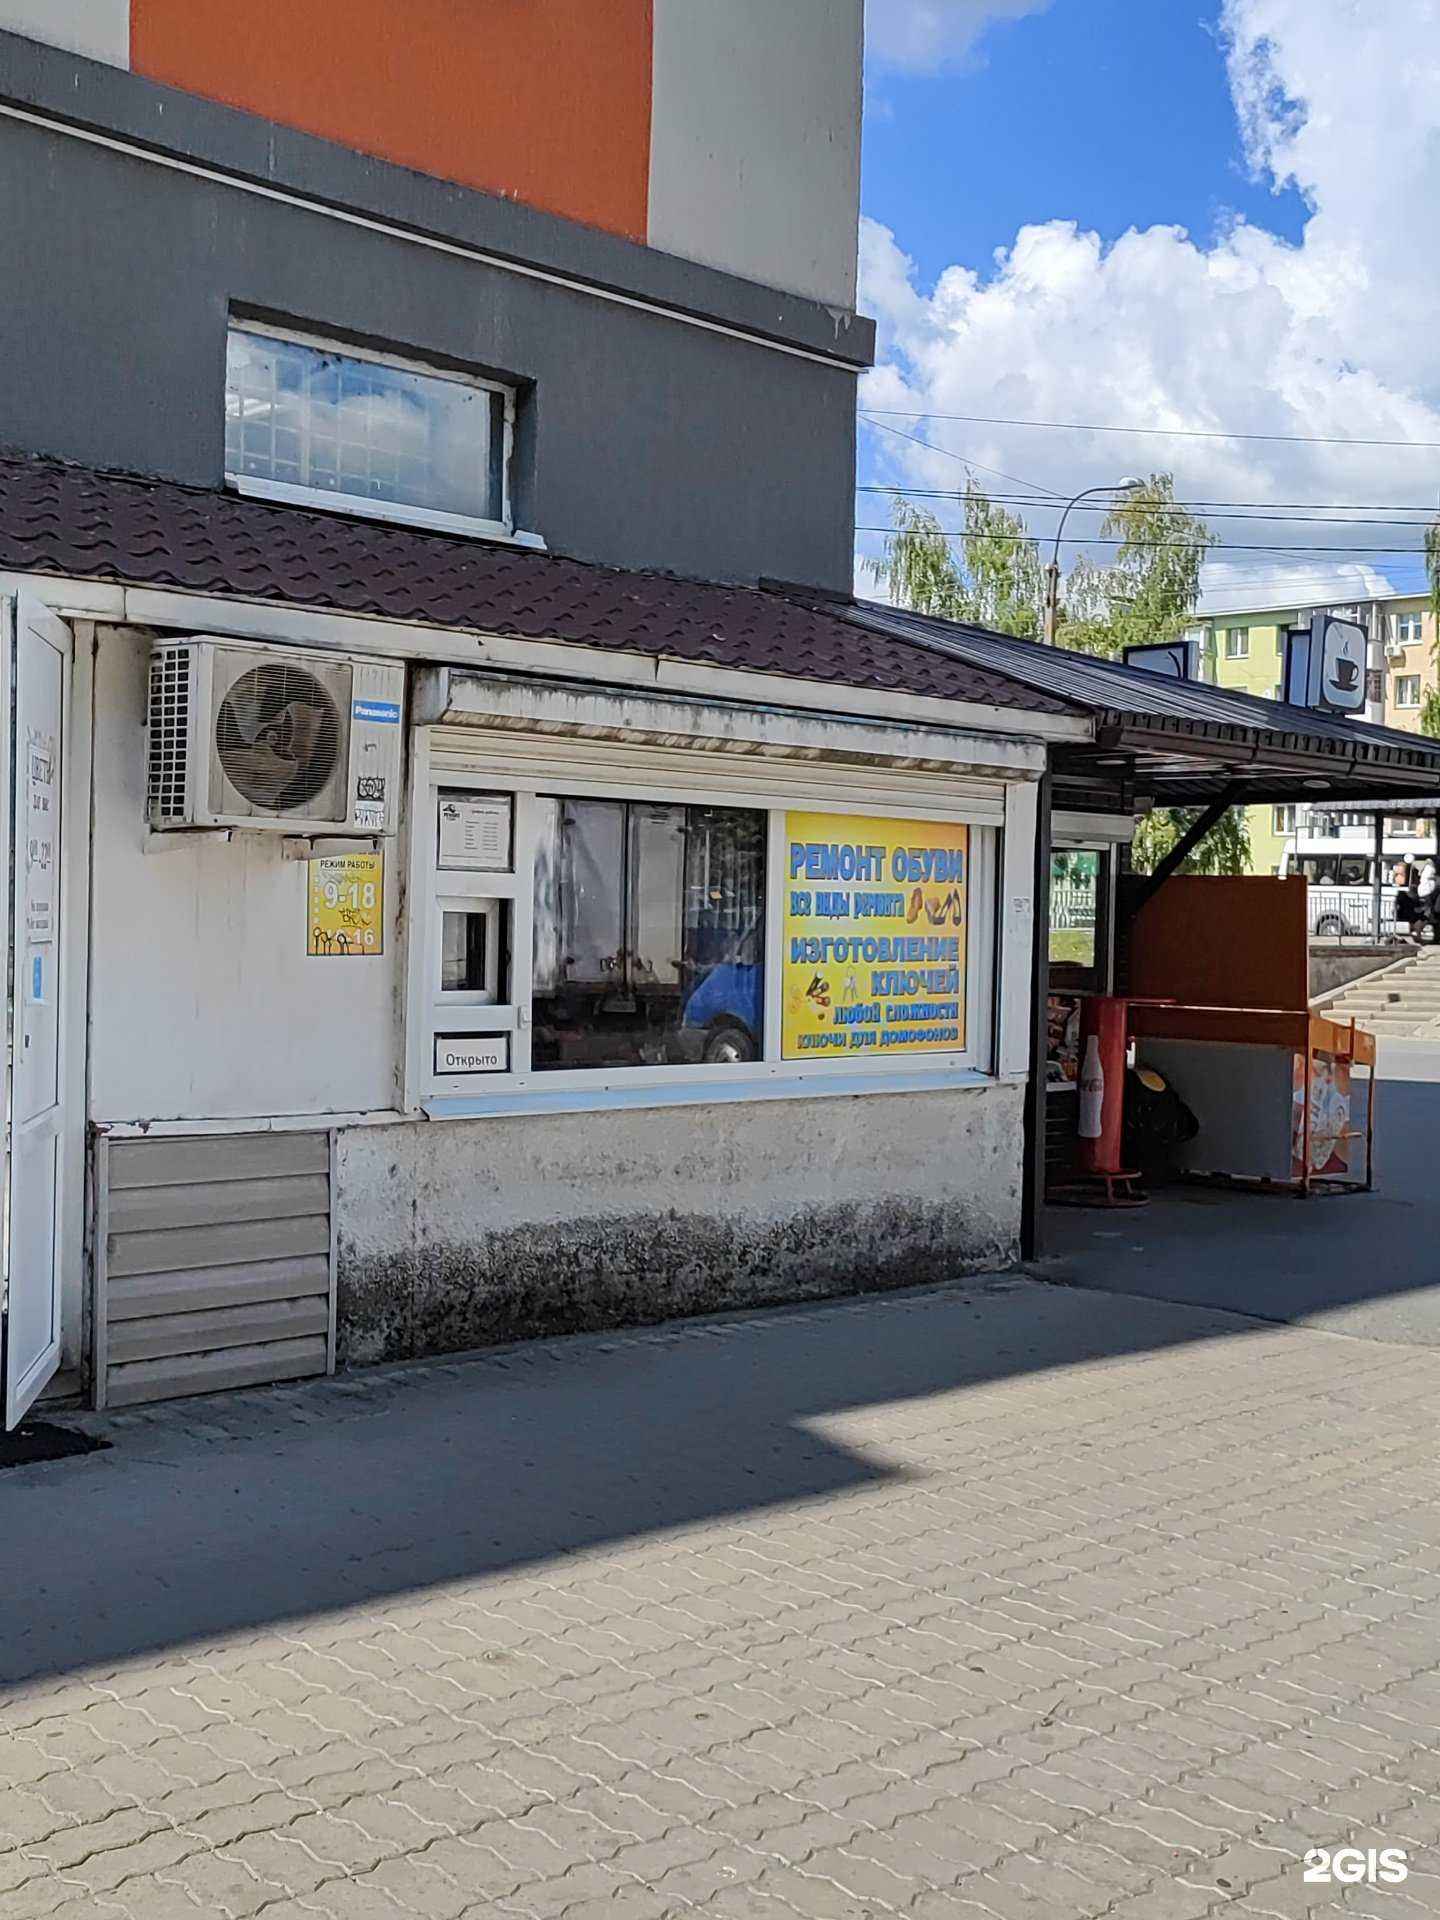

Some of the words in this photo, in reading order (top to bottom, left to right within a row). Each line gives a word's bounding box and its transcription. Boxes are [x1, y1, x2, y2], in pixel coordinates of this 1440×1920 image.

[320, 859, 346, 869] РЕЖИМ
[347, 860, 376, 870] РАБОТЫ
[790, 842, 887, 882] РЕМОНТ
[892, 847, 963, 884] ОБУВИ
[324, 880, 376, 909] 9-18
[791, 936, 960, 964] ИЗГОТОВЛЕНИЕ
[871, 964, 960, 997] КЛЮЧЕЙ
[797, 1031, 846, 1050] КЛЮЧИ
[879, 1026, 959, 1048] ДОМОФОНОВ
[446, 1053, 498, 1068] Открыто
